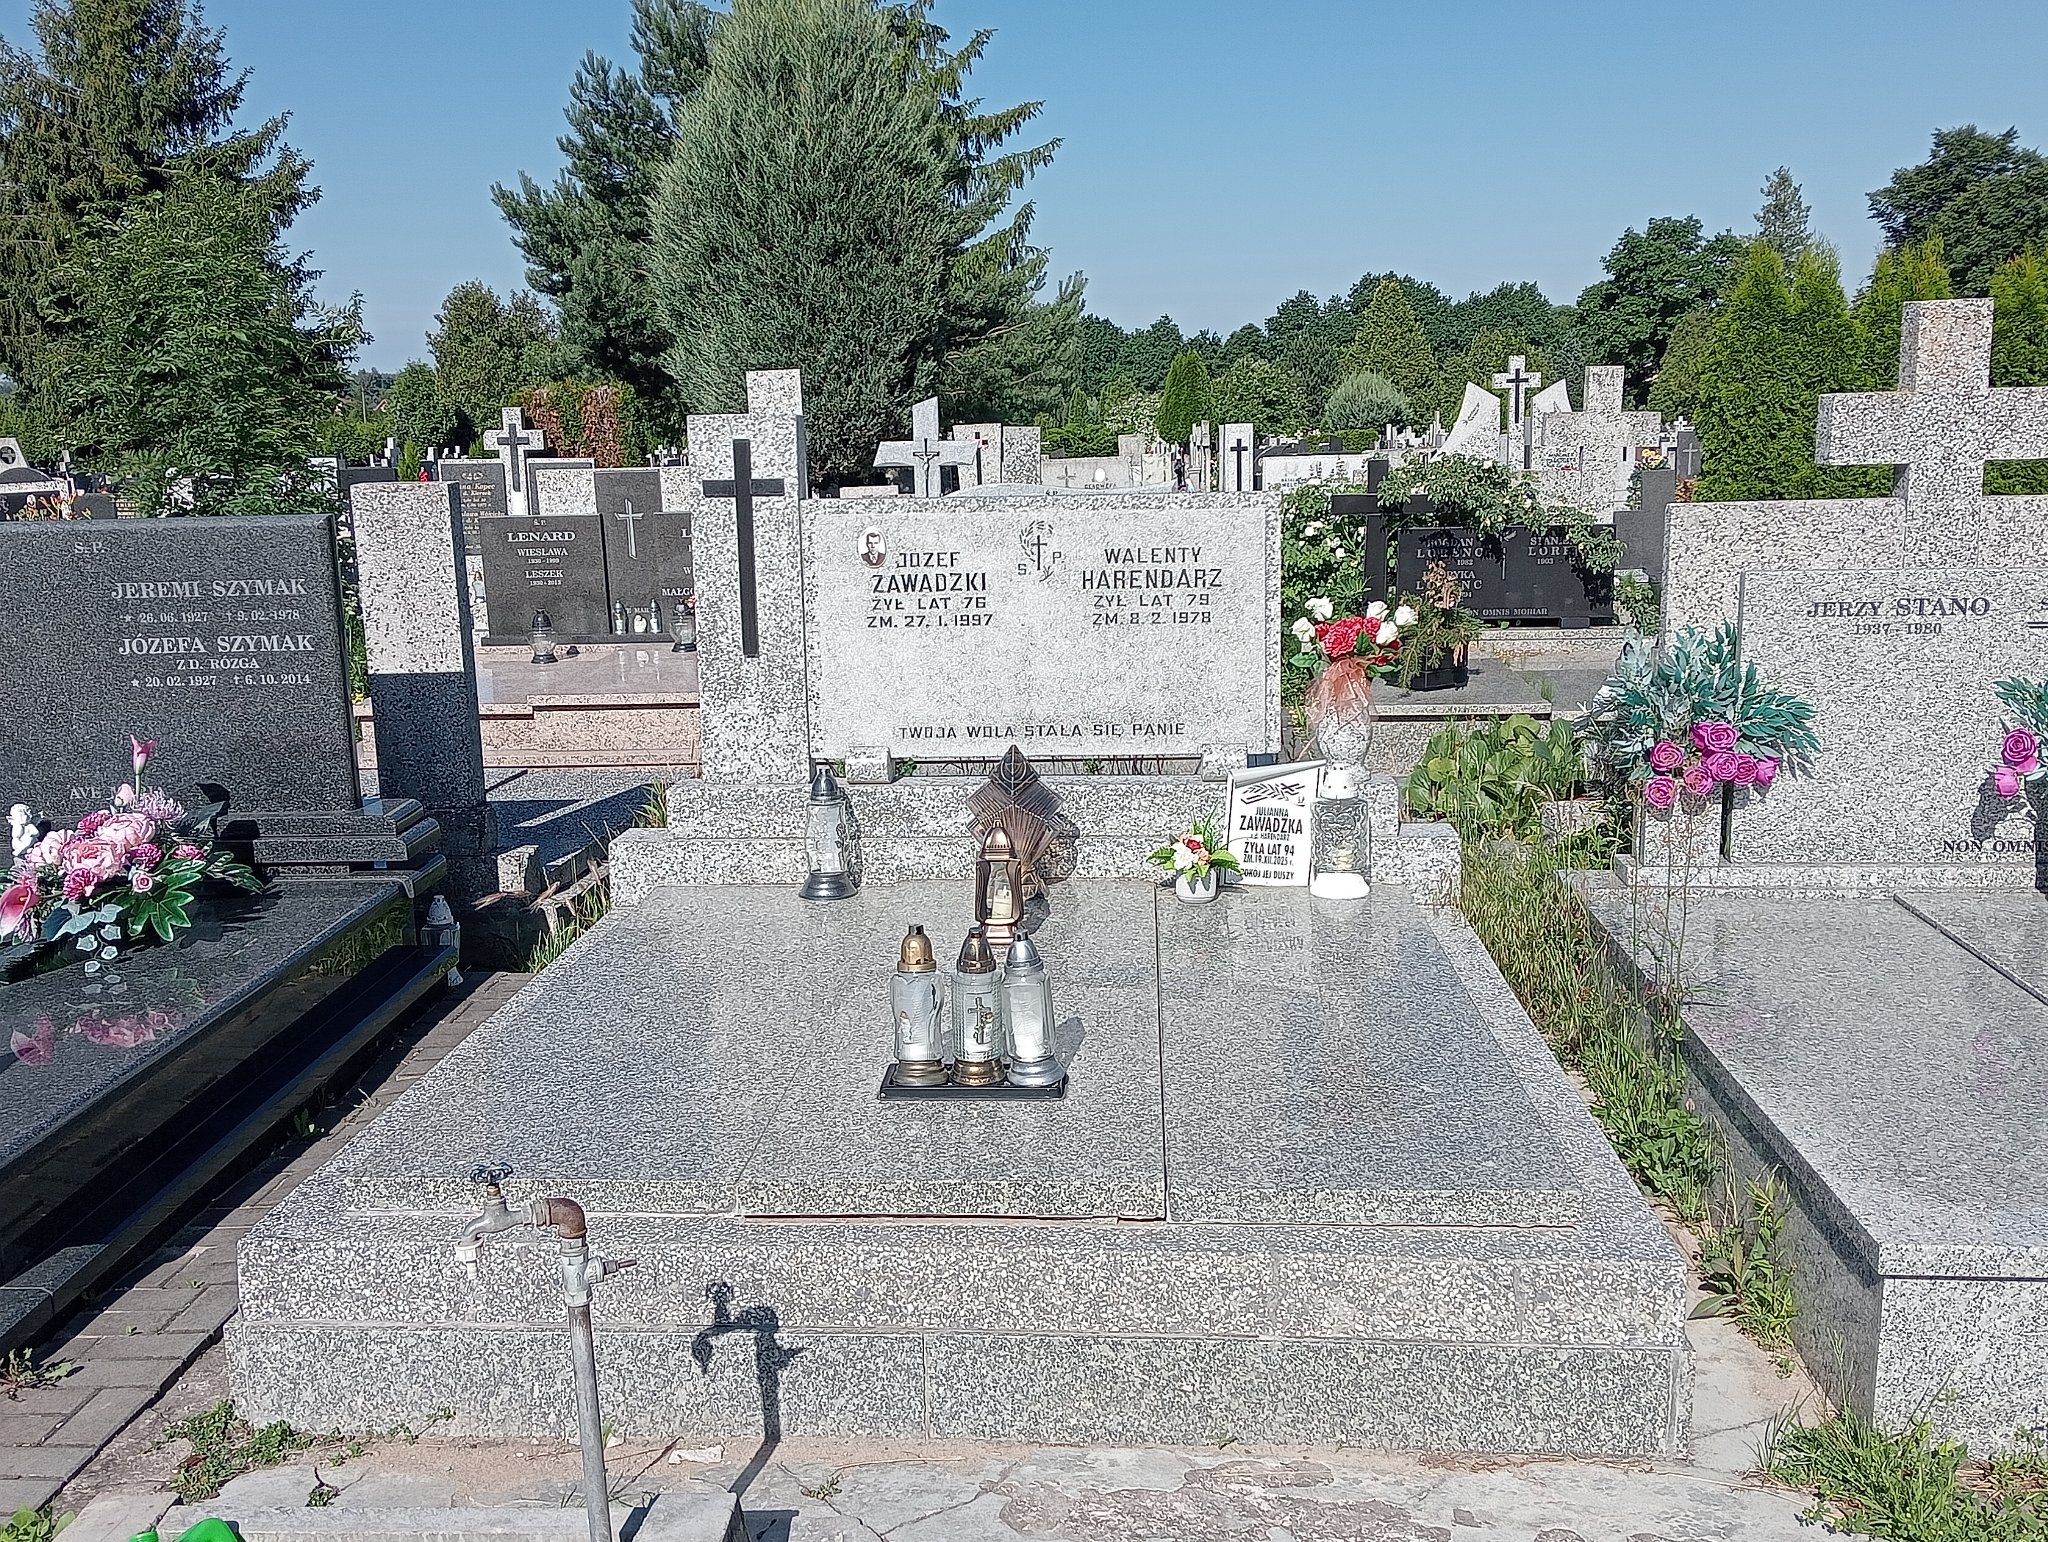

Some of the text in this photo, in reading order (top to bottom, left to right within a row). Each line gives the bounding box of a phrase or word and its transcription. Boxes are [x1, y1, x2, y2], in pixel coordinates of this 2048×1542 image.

[507, 531, 576, 542] LENARD
[1104, 547, 1202, 564] WALENTY
[1416, 547, 1483, 558] LORENC
[525, 570, 564, 579] LESZEK
[1082, 568, 1223, 589] HARENDARZ
[1423, 571, 1476, 579] HRYKA
[111, 578, 308, 600] JEREMI SZYMAK
[871, 572, 987, 593] ZAWADZKI
[1416, 580, 1482, 590] LNC
[918, 597, 951, 610] LAT
[964, 597, 987, 609] 76
[1139, 594, 1173, 607] LAT
[1186, 594, 1210, 606] 79
[1483, 608, 1510, 616] OMNIS
[1513, 608, 1548, 616] MORIAR
[1807, 597, 1990, 618] JERZY STANO
[866, 616, 898, 628] ZM.
[1854, 623, 1890, 635] 1937
[1905, 622, 1942, 635] 1980
[118, 633, 315, 655] JÓZEFA SZYMAK
[209, 655, 260, 669] RÓZGA
[899, 722, 1185, 739] TWOJA WOLA STAŁA SIĘ PANIE
[70, 787, 101, 799] AVE
[1255, 807, 1289, 818] JULIANNA
[1239, 815, 1302, 834] ZAWADZKA
[1267, 843, 1281, 855] LAT
[1284, 844, 1294, 856] 94
[1942, 840, 1982, 852] NON
[1262, 869, 1272, 879] JEJ
[1273, 870, 1295, 880] DUSZY
